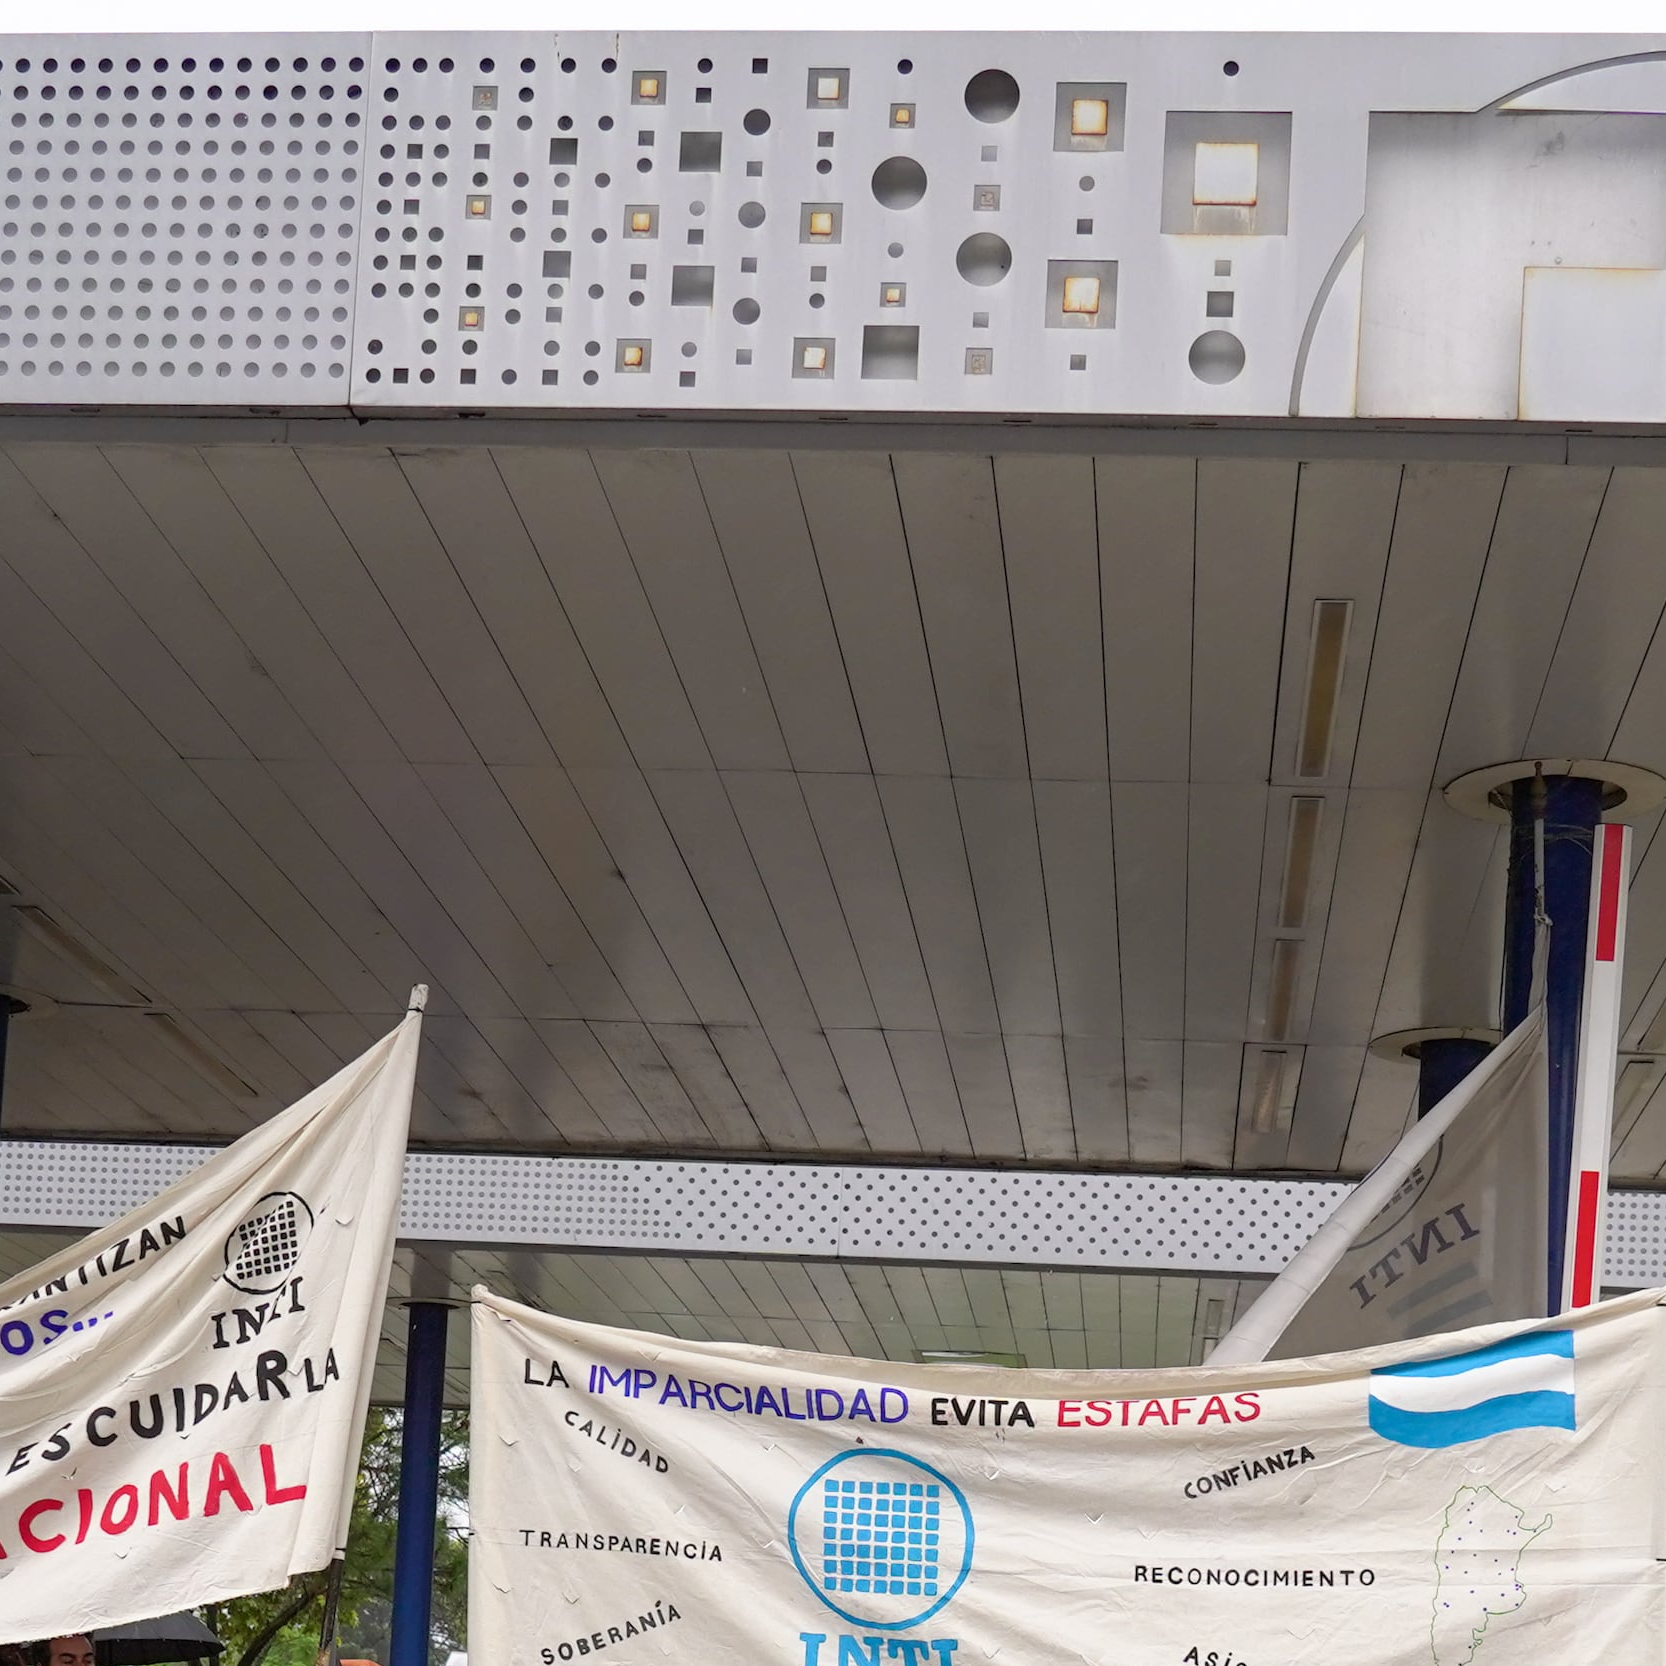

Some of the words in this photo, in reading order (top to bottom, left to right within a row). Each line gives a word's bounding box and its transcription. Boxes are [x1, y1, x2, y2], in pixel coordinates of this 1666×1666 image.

[6, 1422, 72, 1476] ES
[86, 1349, 290, 1446] CUIDAR
[303, 1347, 340, 1393] LA
[524, 1358, 570, 1389] LA
[589, 1365, 909, 1424] IMPARCIALIDAD
[931, 1397, 1036, 1429] EVITA
[1057, 1392, 1261, 1428] ESTAFAS
[1134, 1565, 1375, 1587] RECONOCIMIENTO
